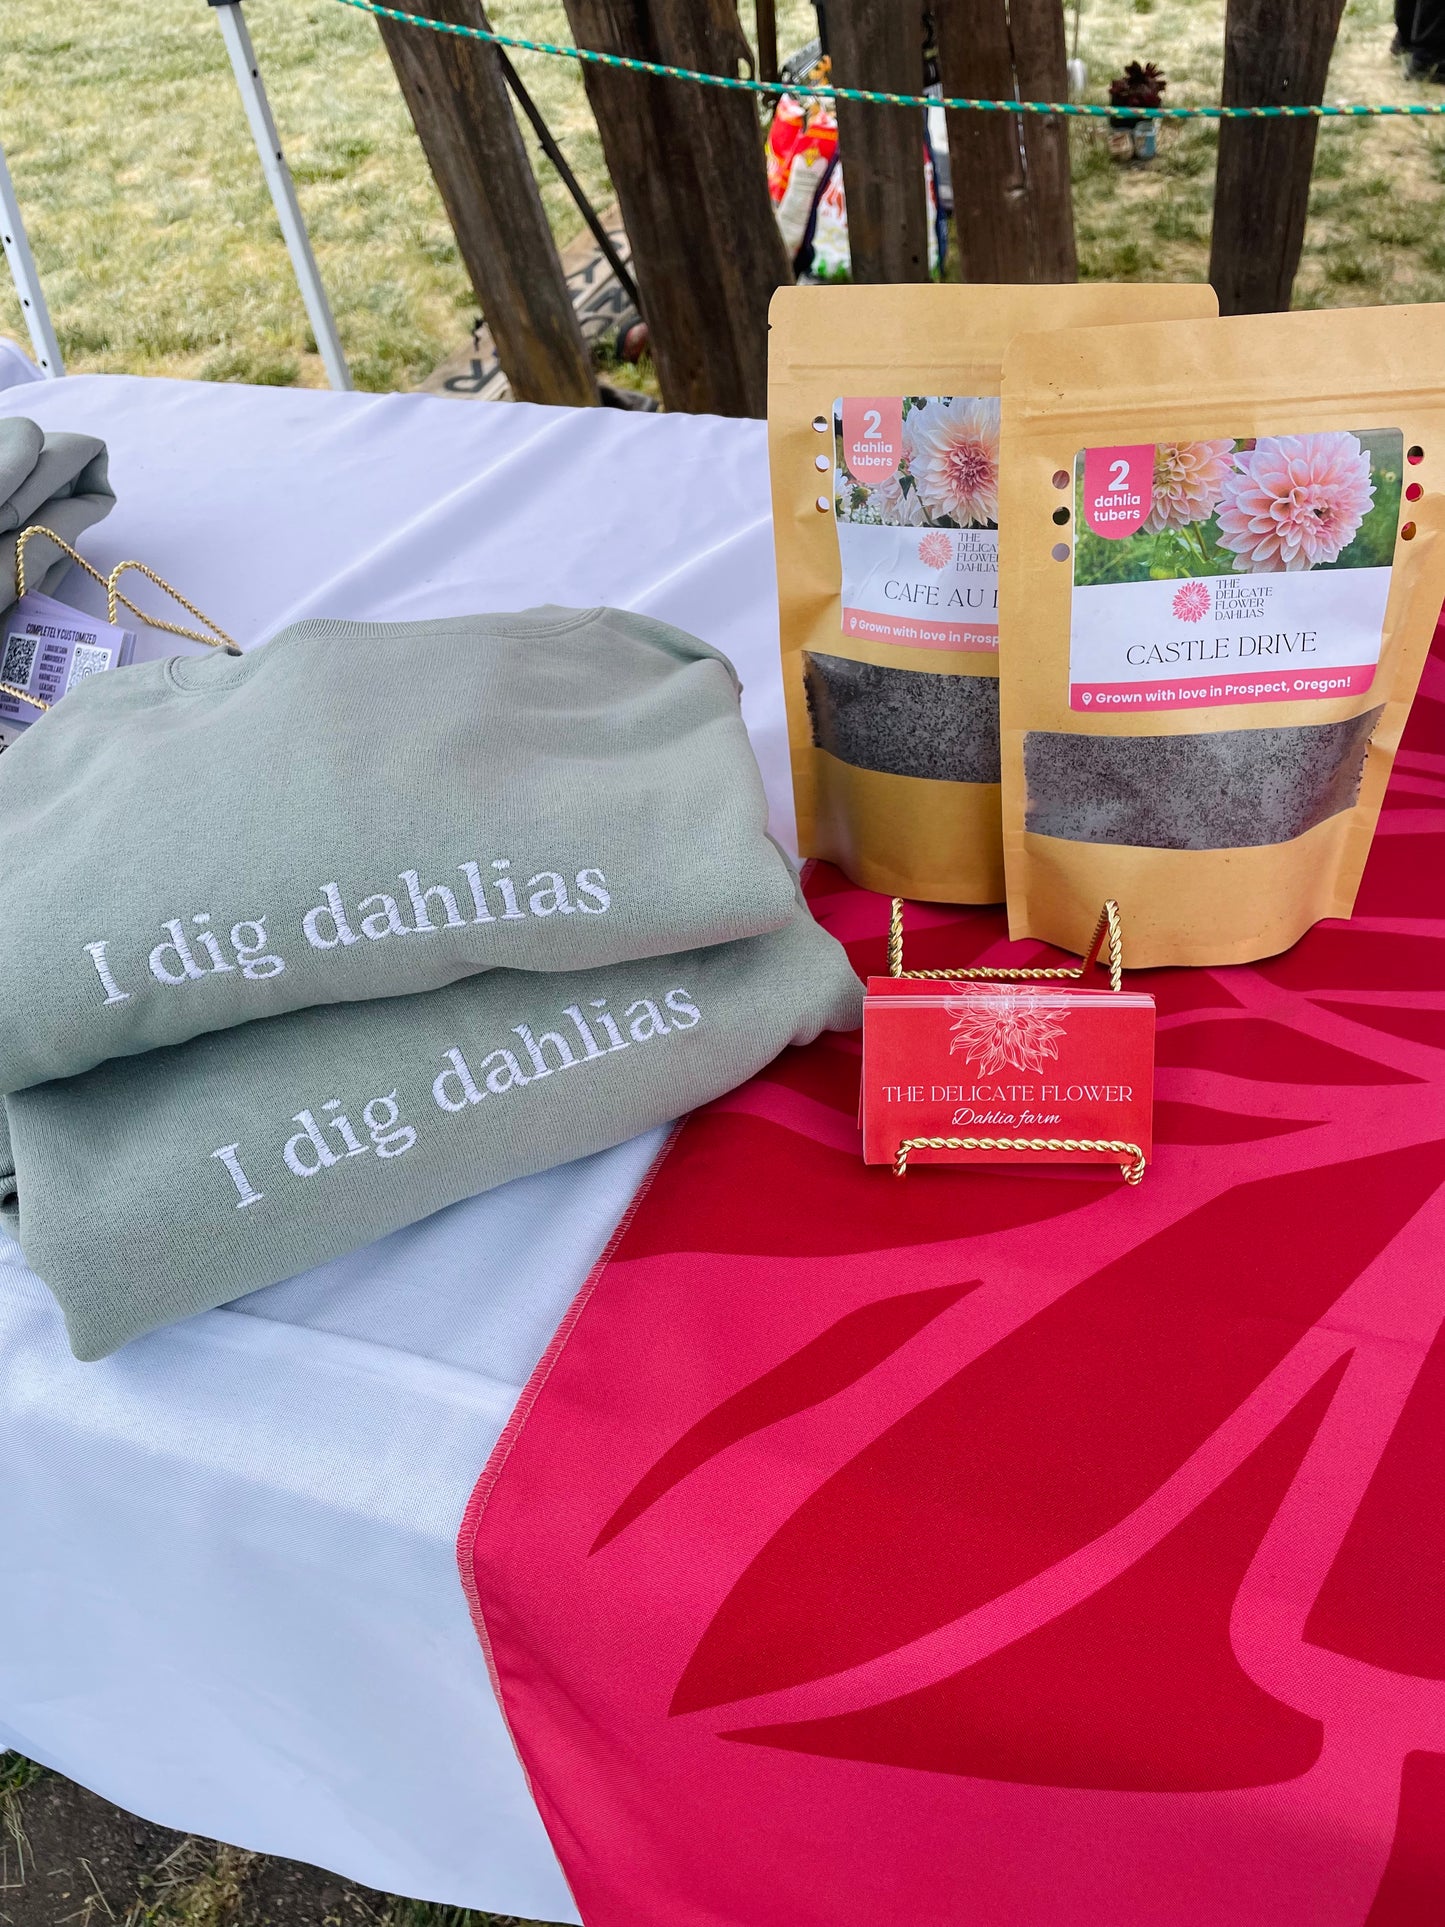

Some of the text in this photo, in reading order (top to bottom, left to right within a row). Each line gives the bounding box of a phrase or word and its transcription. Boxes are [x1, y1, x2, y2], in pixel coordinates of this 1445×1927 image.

[863, 410, 882, 439] 2
[852, 441, 893, 453] dahlia
[852, 455, 893, 467] tubers
[1108, 459, 1130, 491] 2
[1094, 493, 1141, 508] dahlia
[1094, 509, 1140, 522] tubers
[958, 532, 981, 543] THE
[957, 543, 999, 553] DELICA
[956, 553, 999, 563] FLOWE
[1216, 578, 1240, 589] THE
[884, 580, 940, 606] CAFE
[947, 588, 985, 608] AU
[1215, 586, 1273, 599] DELICATE
[1215, 598, 1265, 610] FLOWER
[1214, 608, 1265, 621] DAHLIAS
[26, 623, 97, 645] COMPLETELY CUSTOMIZED
[858, 619, 891, 635] Grown
[893, 626, 917, 638] with
[920, 631, 946, 642] love
[949, 631, 961, 642] in
[1126, 631, 1317, 666] CASTLE DRIVE
[1096, 676, 1351, 705] Grown with love in Prospect, Oregon!
[83, 859, 612, 1005] I dig dahlias
[210, 987, 703, 1209] I dig dahlias
[882, 1085, 1134, 1103] THE DELICATE FLOWER
[951, 1107, 1063, 1129] Dahlia farm
